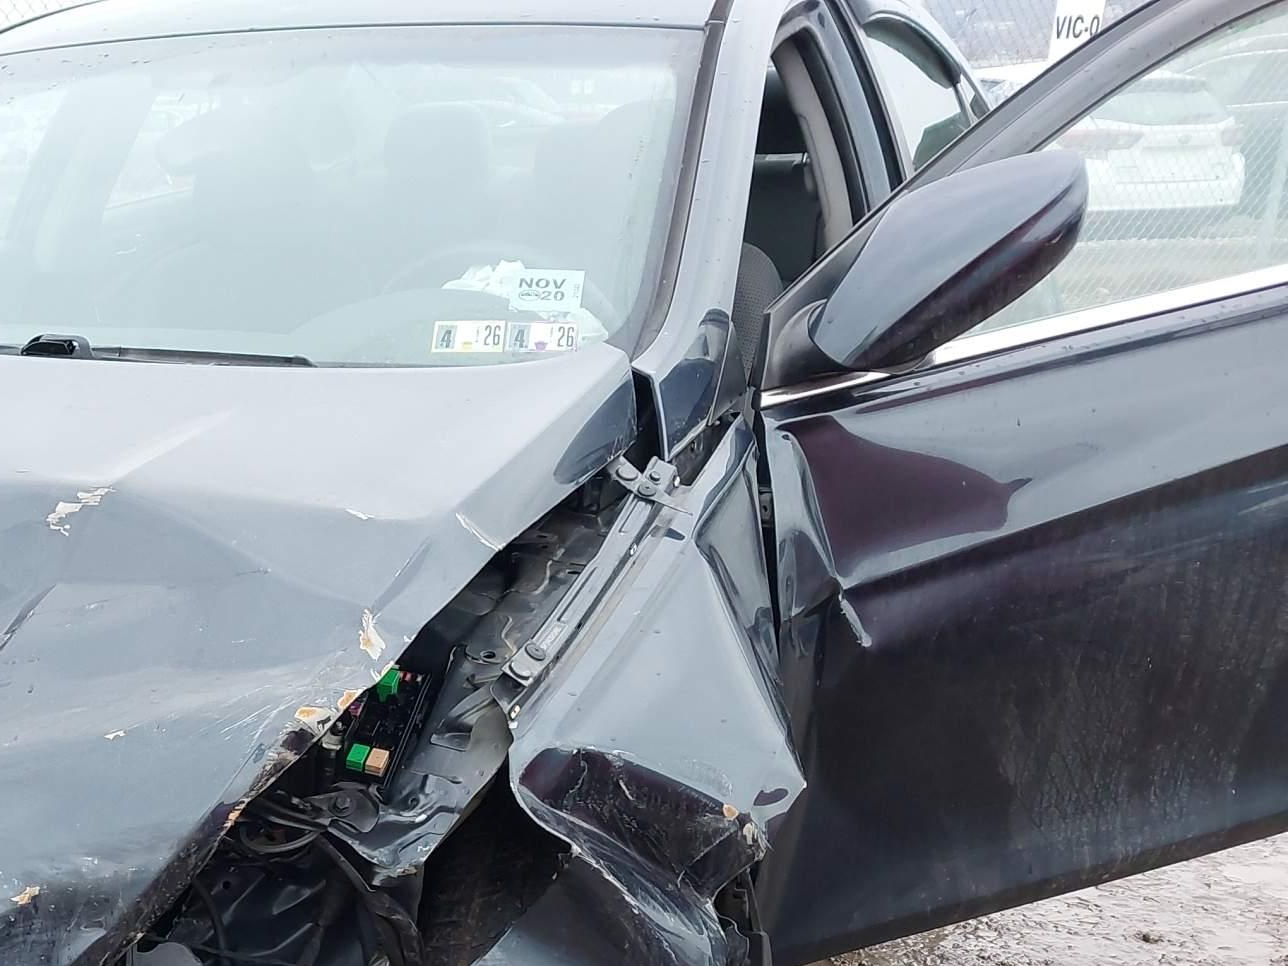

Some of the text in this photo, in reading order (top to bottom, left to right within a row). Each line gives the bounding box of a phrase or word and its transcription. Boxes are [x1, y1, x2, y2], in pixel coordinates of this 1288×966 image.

[519, 277, 567, 289] NOV
[540, 290, 565, 301] 20
[440, 329, 453, 349] 4
[483, 324, 502, 346] 26
[514, 329, 526, 348] 4
[556, 326, 575, 347] 26
